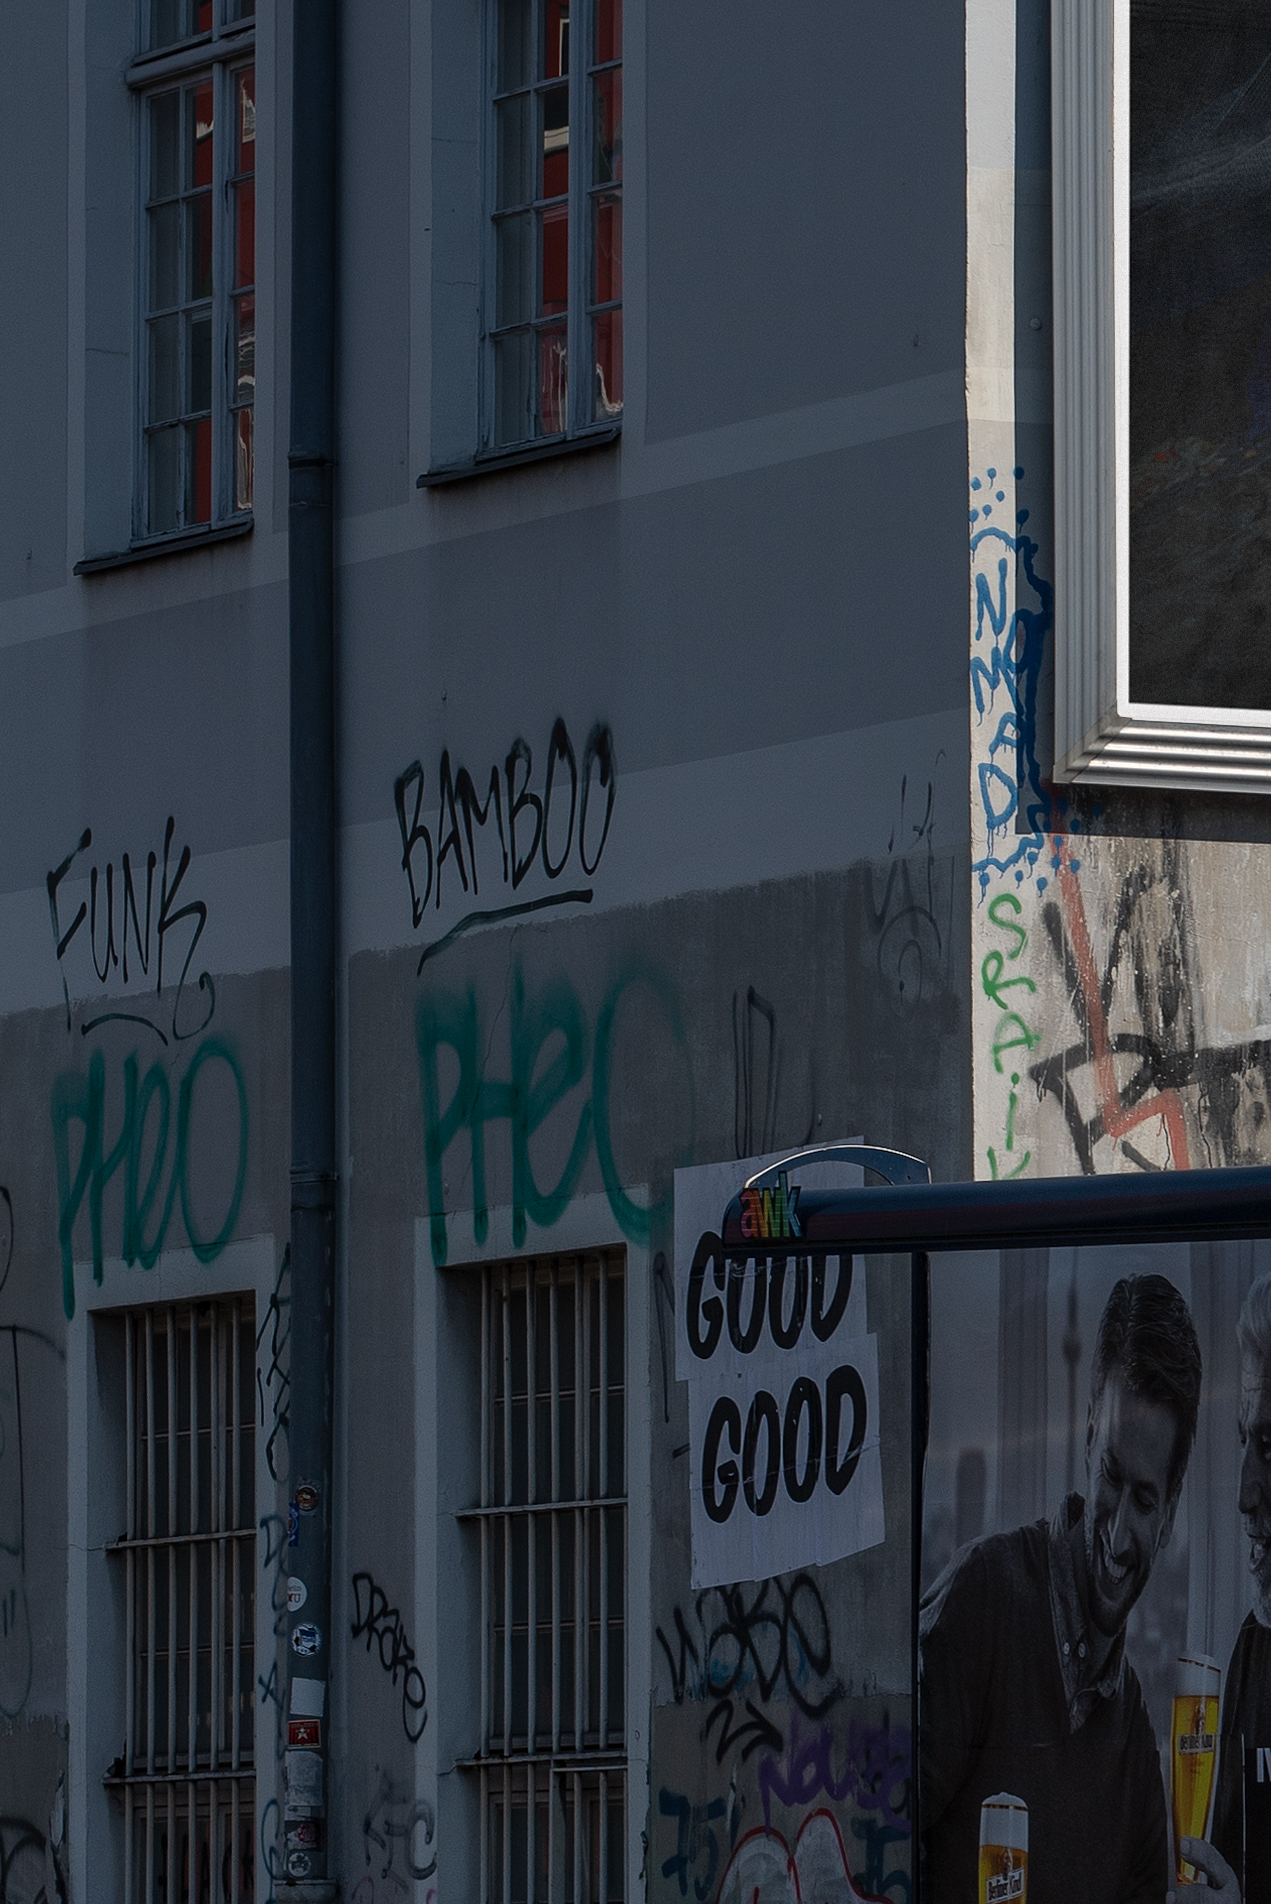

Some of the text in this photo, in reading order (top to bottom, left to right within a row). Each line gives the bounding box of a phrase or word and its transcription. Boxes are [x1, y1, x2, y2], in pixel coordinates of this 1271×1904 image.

[394, 715, 618, 929] BAMBOO
[738, 1170, 802, 1239] awk
[686, 1230, 853, 1360] GOOD
[702, 1364, 868, 1523] GOOD
